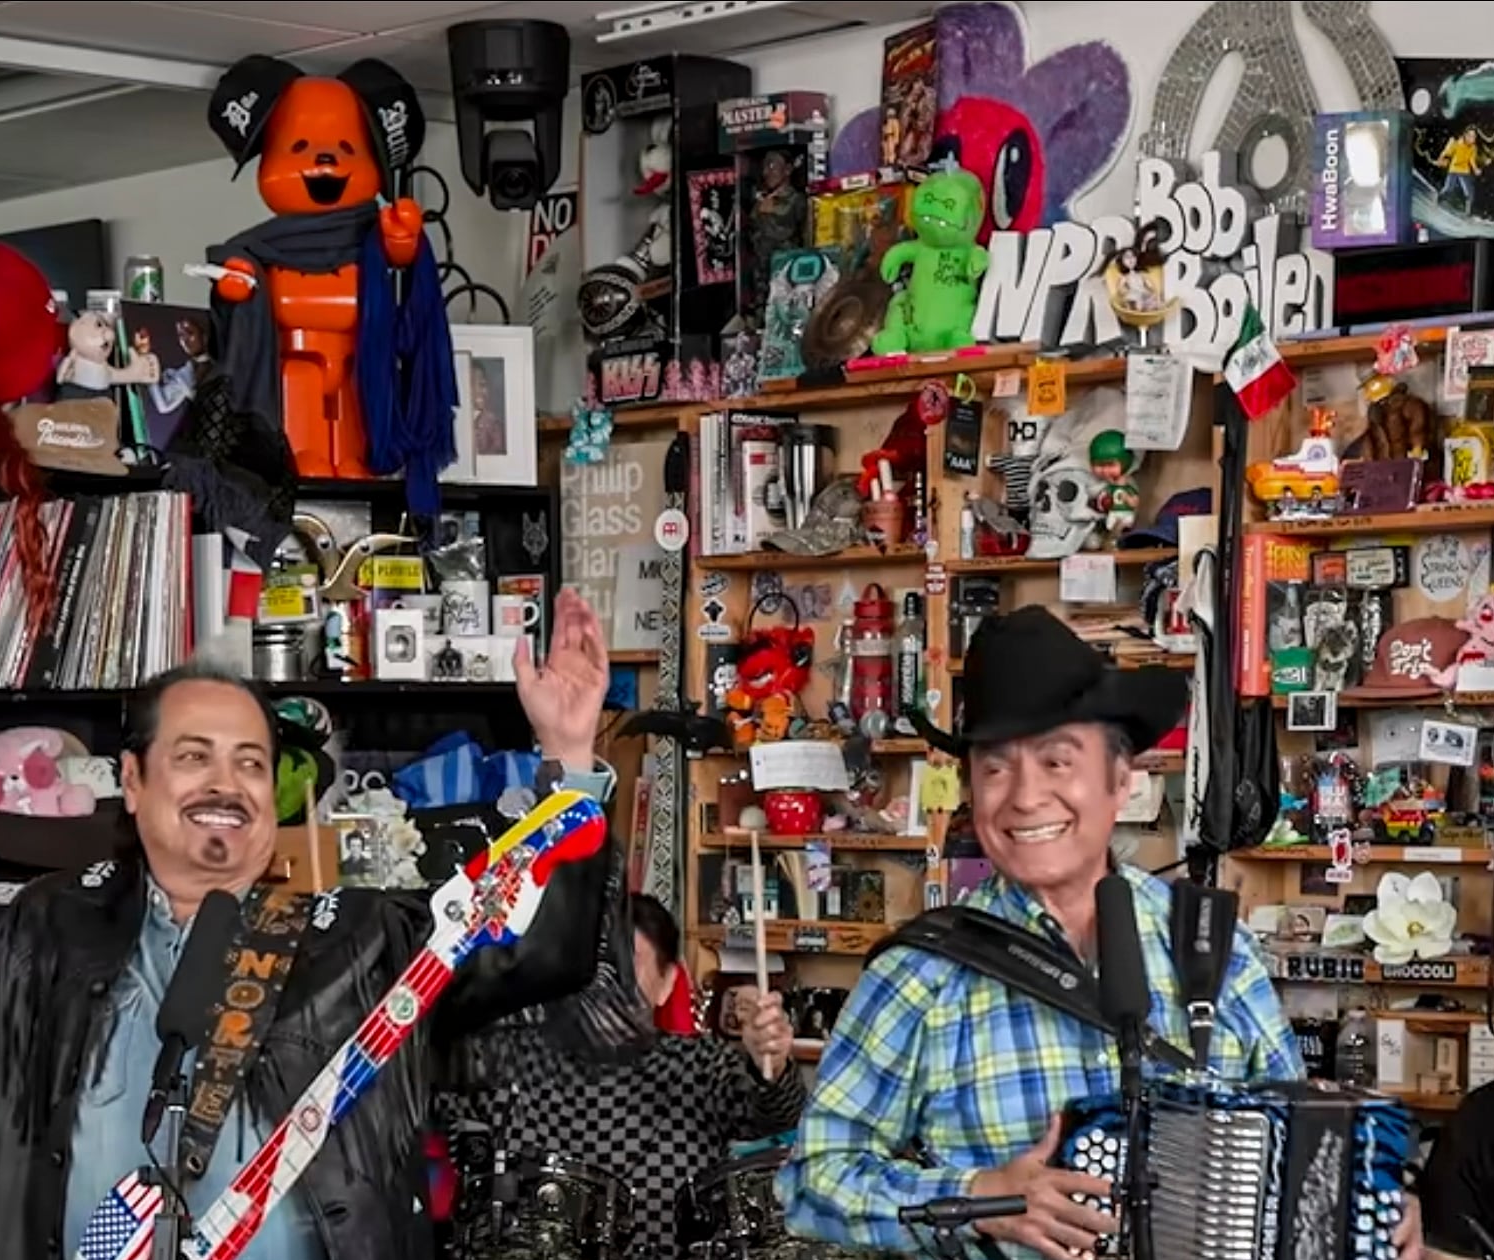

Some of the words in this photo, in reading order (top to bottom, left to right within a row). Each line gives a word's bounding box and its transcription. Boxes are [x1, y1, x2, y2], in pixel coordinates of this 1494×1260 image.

[1321, 129, 1340, 234] HwaBoon
[534, 199, 571, 230] NO
[1141, 152, 1246, 256] Bob
[972, 216, 1137, 344] NPR
[604, 358, 661, 399] KISS
[562, 459, 643, 493] Philip
[562, 500, 642, 535] Glass
[1287, 956, 1363, 980] RUBIO
[1383, 962, 1456, 980] BROCCOLI
